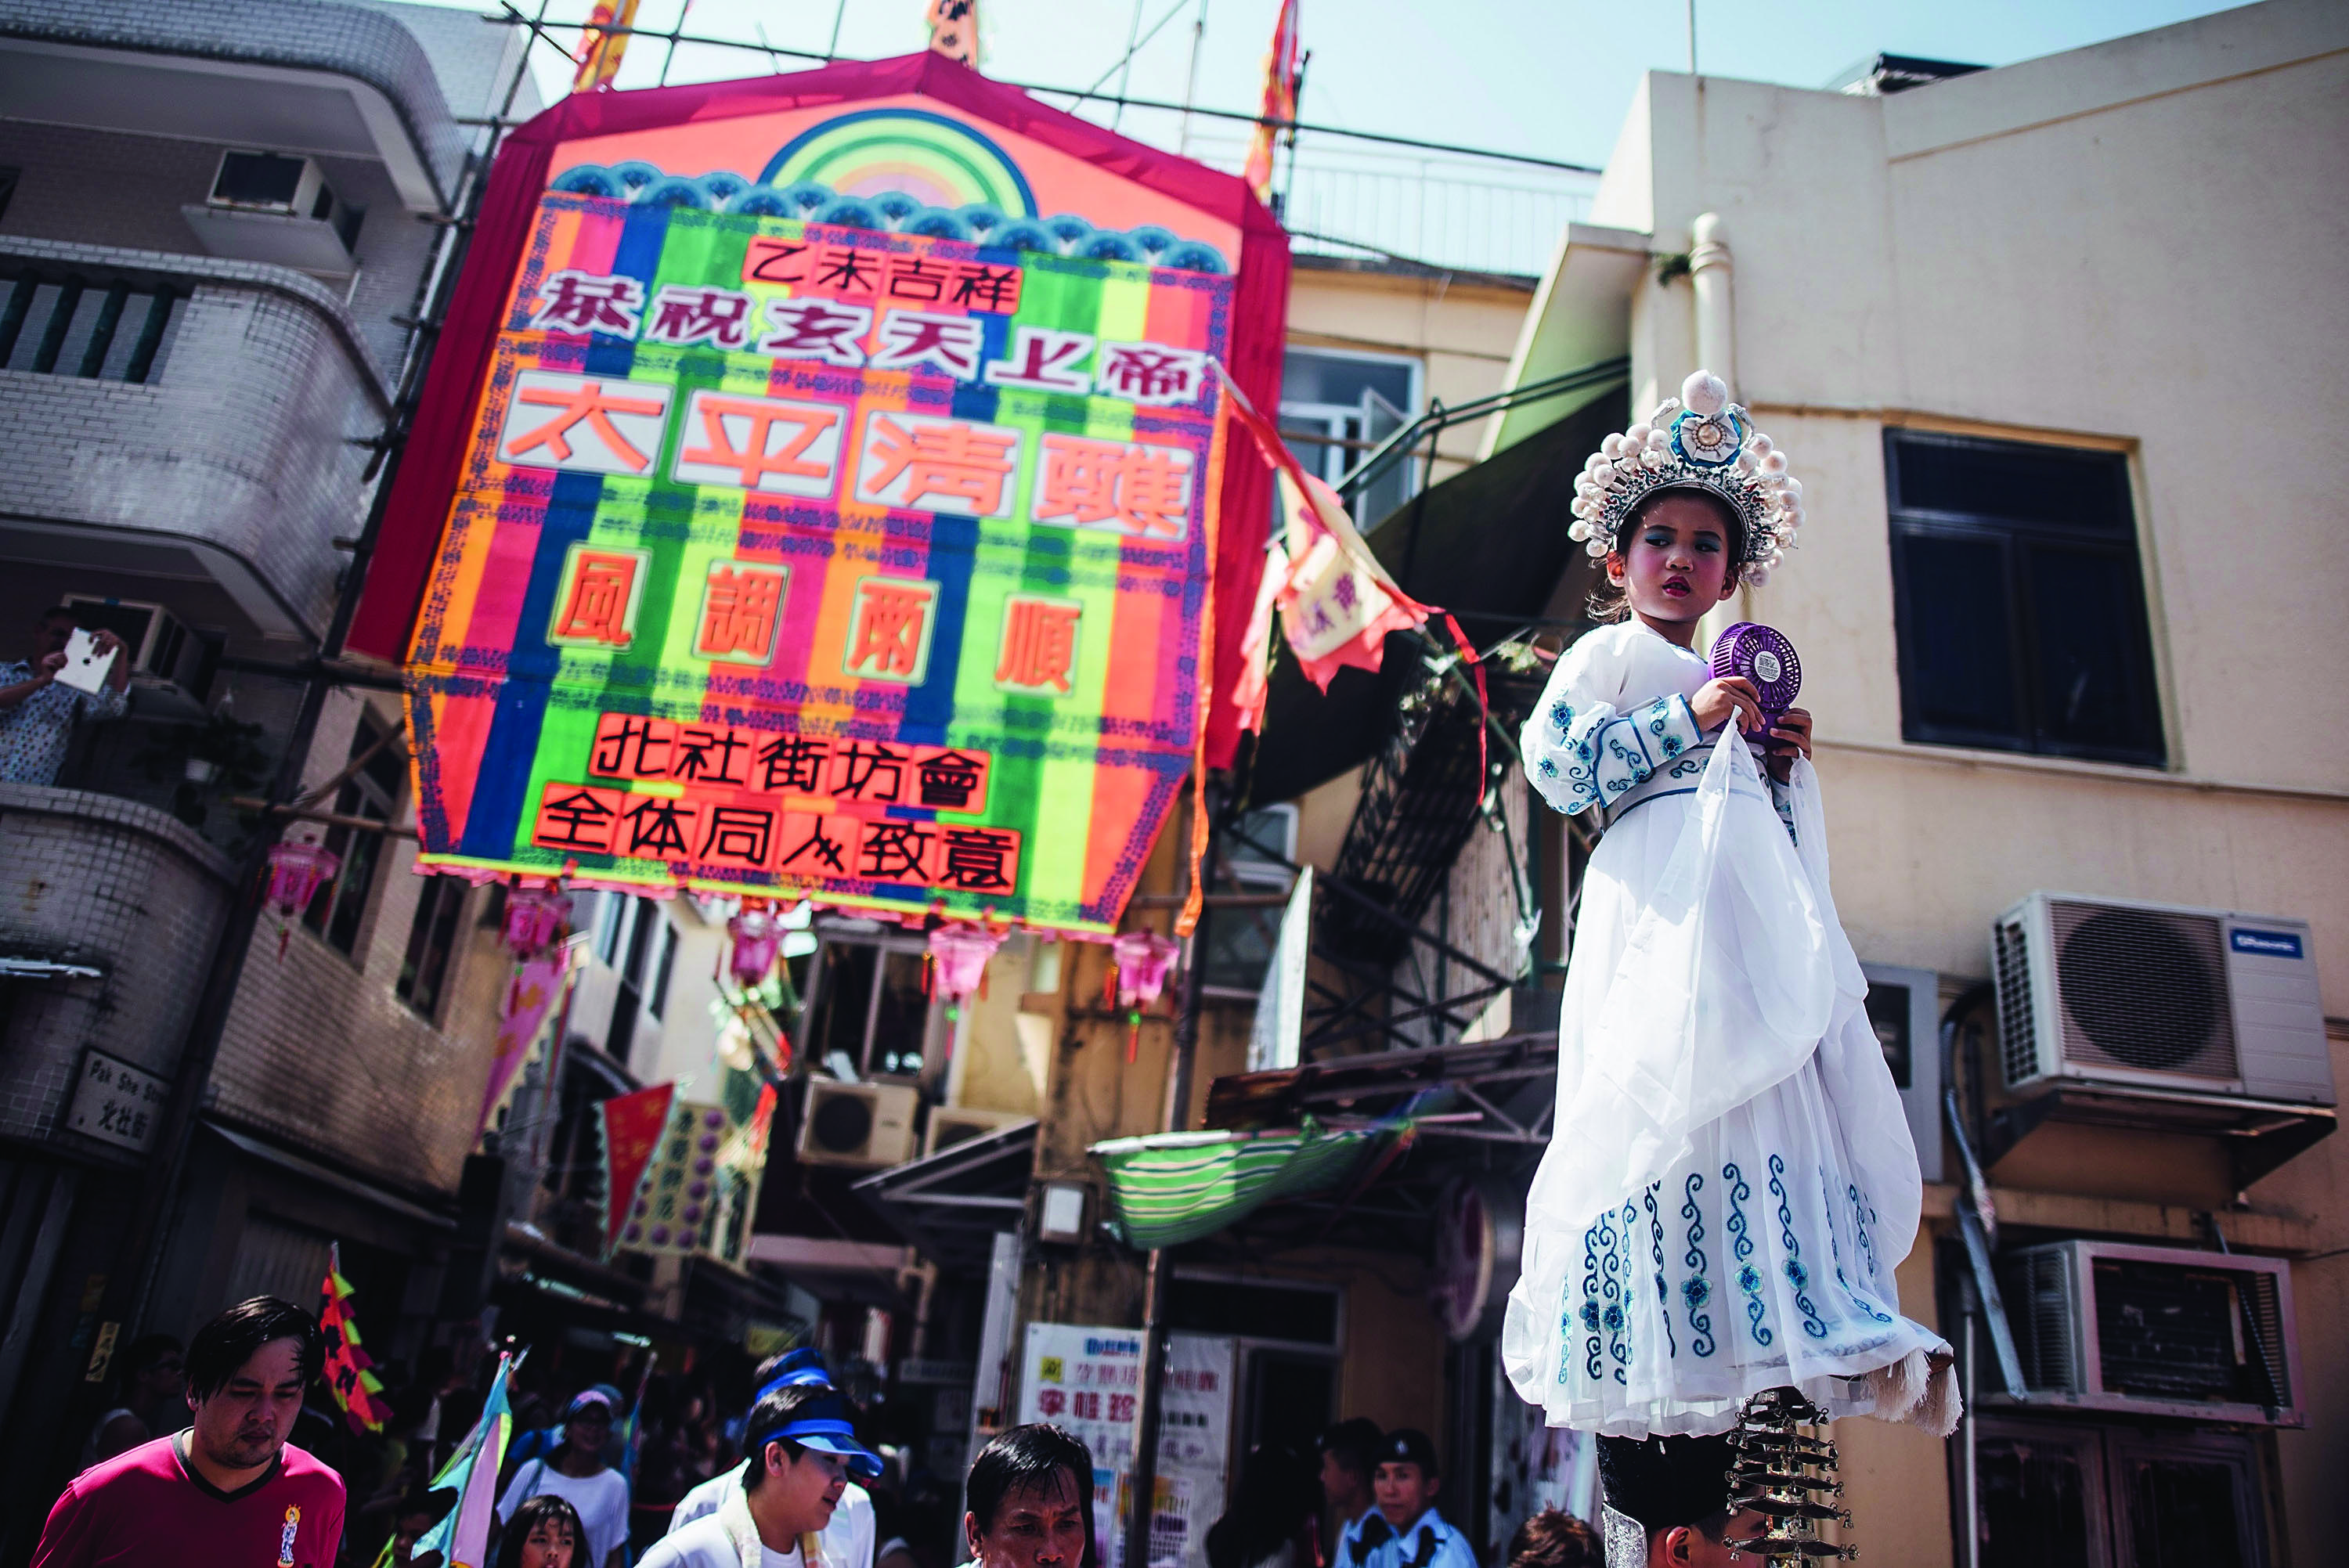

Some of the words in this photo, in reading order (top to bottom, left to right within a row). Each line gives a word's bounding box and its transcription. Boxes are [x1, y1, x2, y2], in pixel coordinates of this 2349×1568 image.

[535, 271, 1203, 403] 恭祝玄天上帝
[749, 241, 1019, 312] 乙未吉祥
[505, 382, 1190, 537] 太平清醮
[554, 550, 1083, 694] 風調雨順
[597, 718, 986, 807] 北社街坊會
